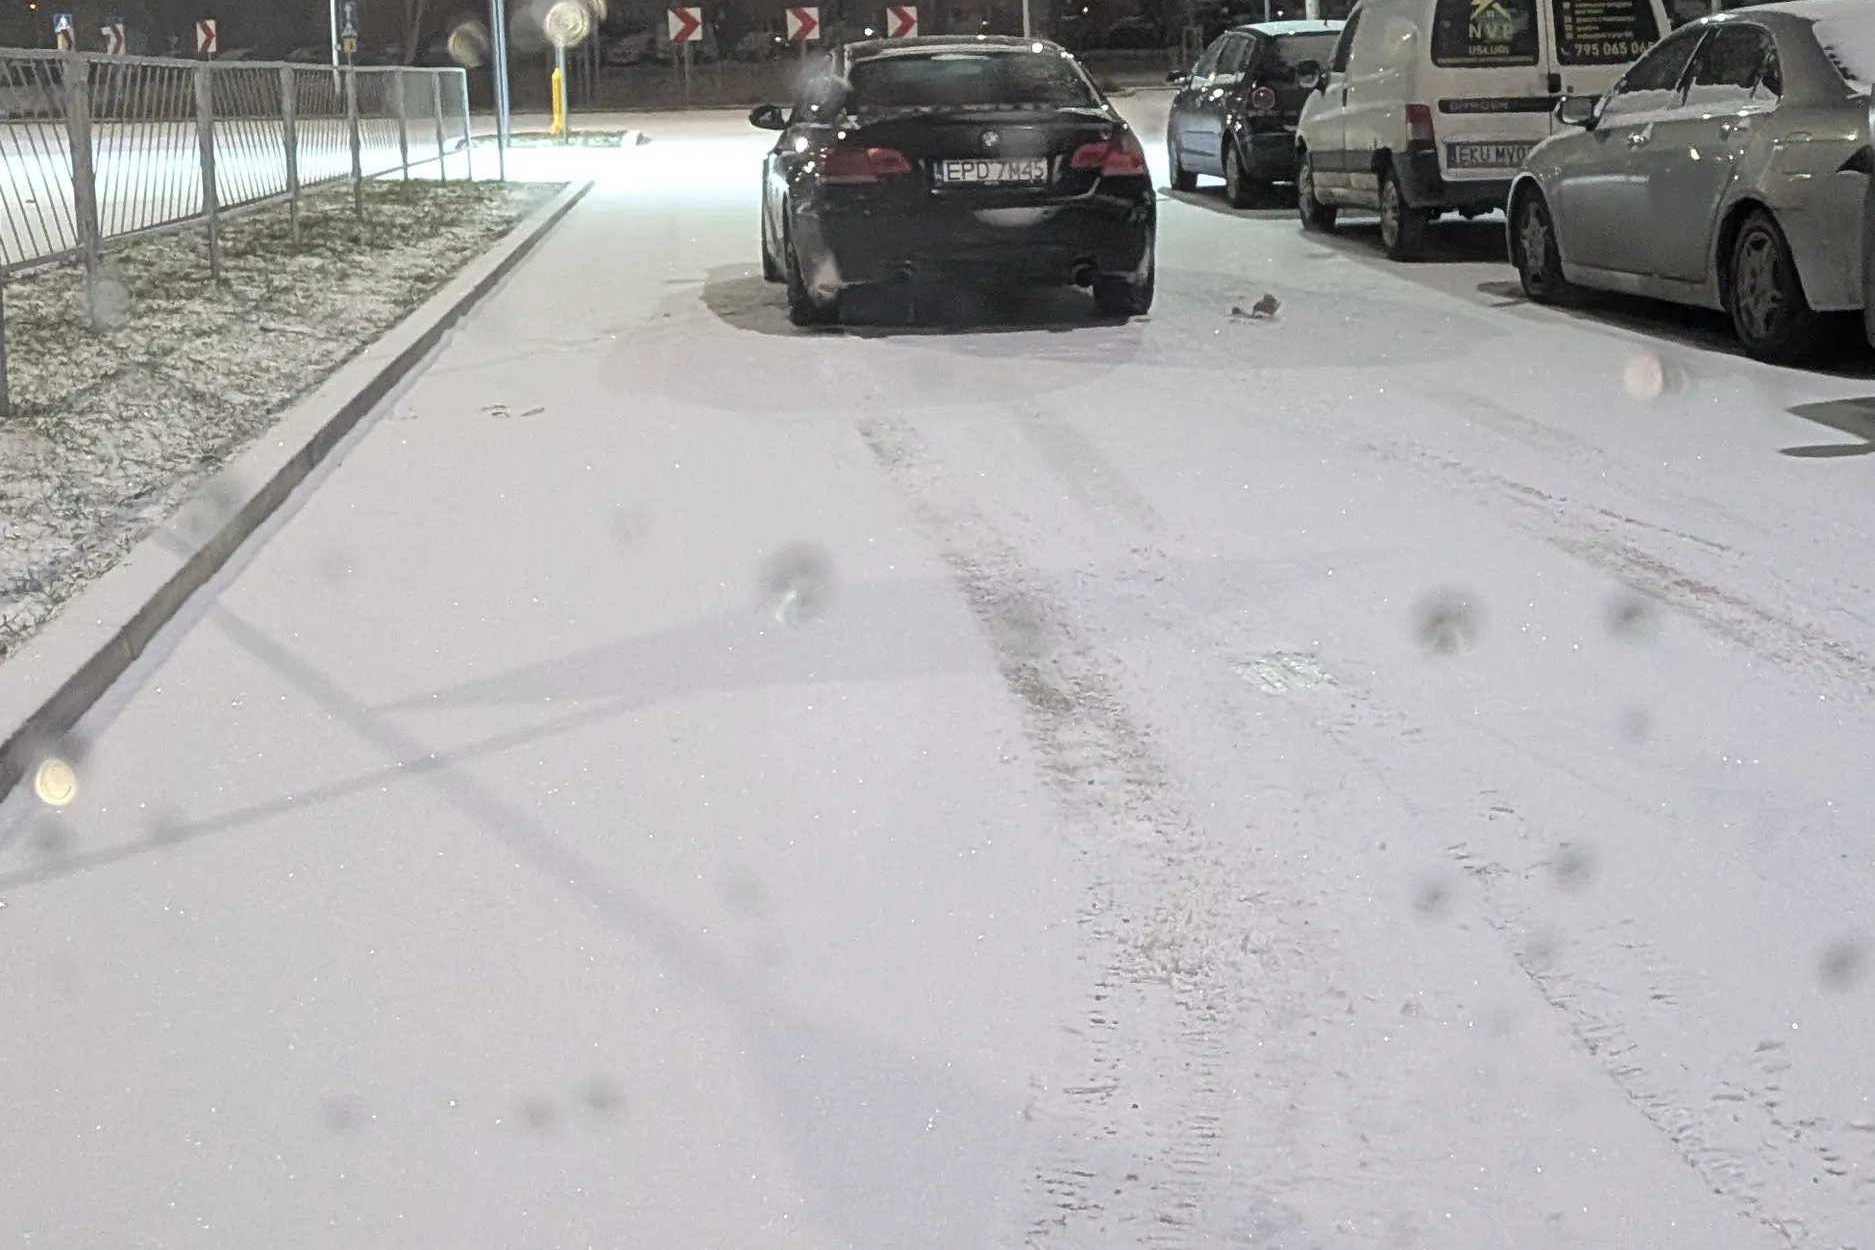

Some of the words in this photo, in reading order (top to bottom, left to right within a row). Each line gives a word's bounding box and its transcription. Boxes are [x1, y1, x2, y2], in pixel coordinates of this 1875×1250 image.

[1575, 43, 1600, 57] 795
[1602, 42, 1627, 56] 065
[1460, 146, 1489, 162] EKU
[947, 161, 990, 181] EPD
